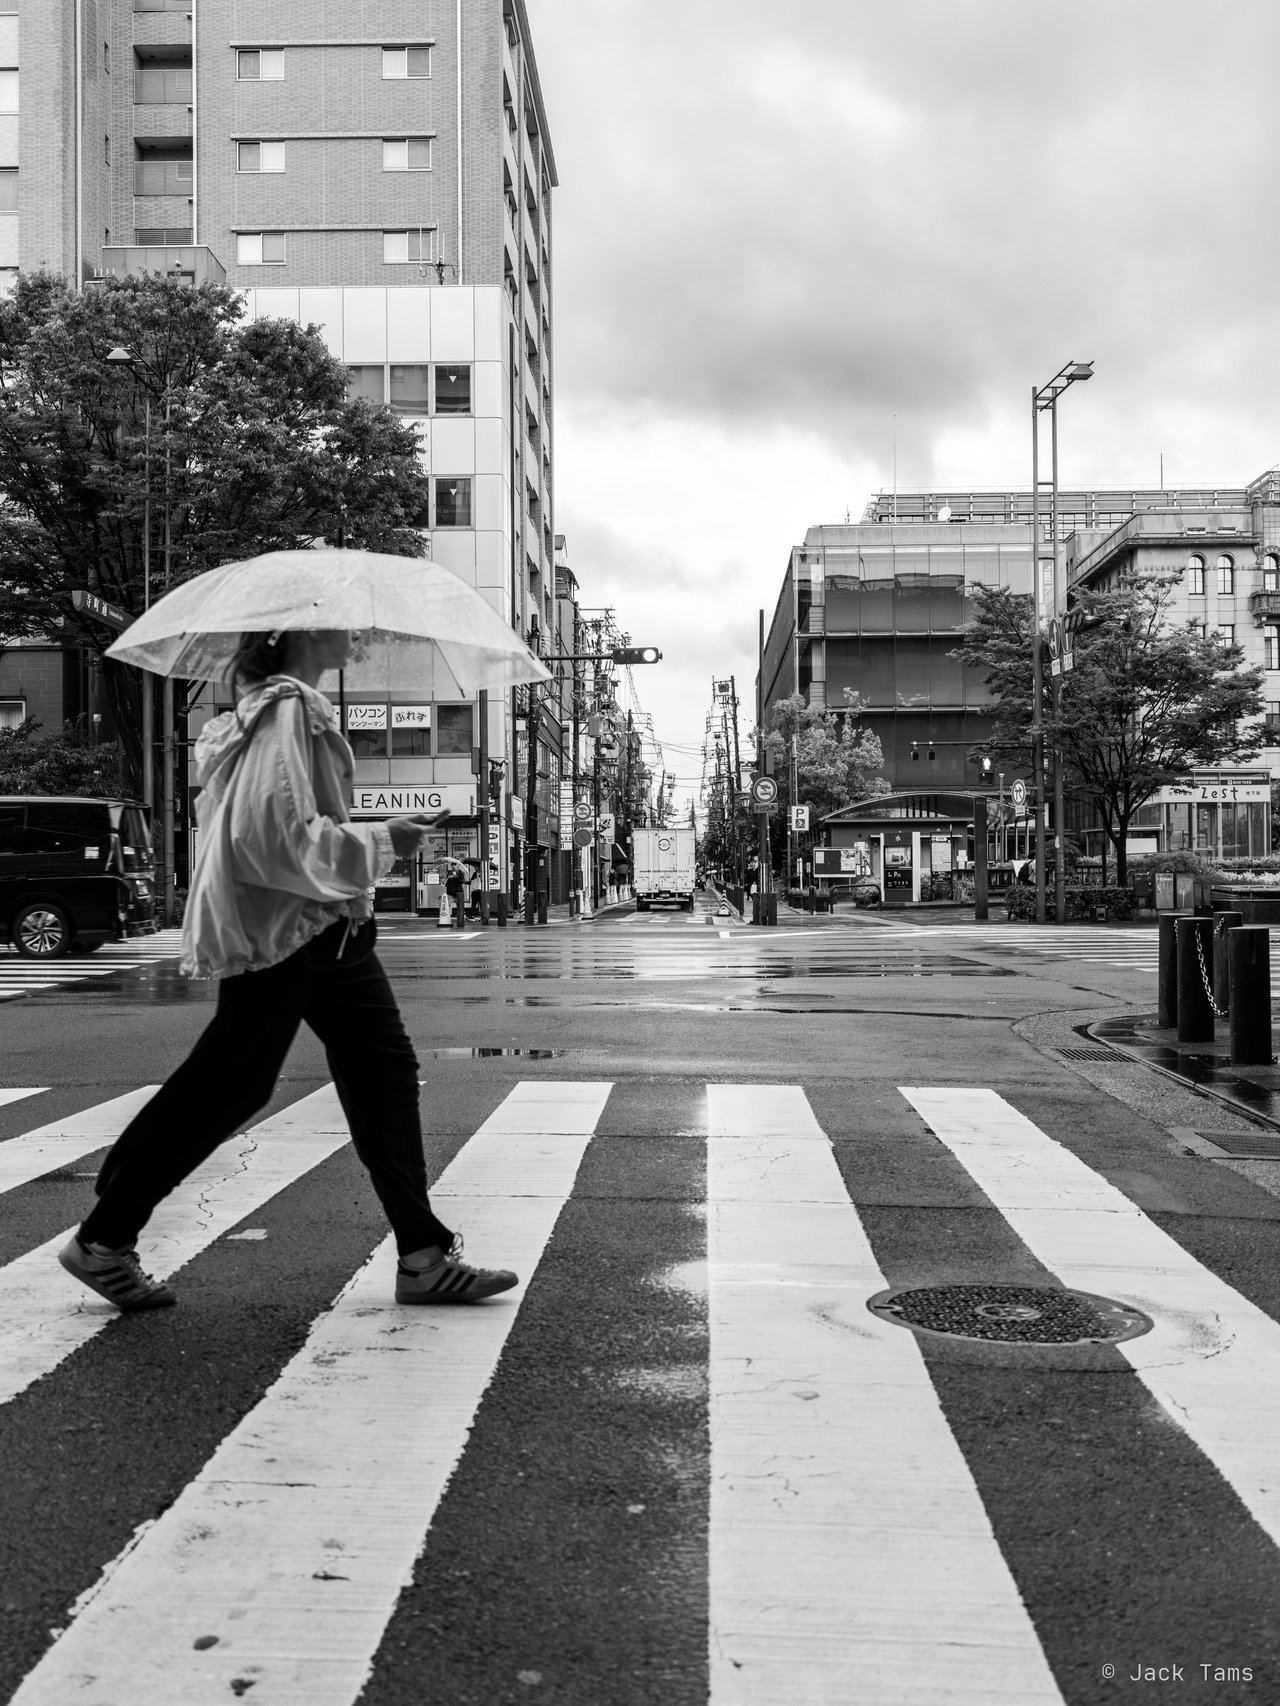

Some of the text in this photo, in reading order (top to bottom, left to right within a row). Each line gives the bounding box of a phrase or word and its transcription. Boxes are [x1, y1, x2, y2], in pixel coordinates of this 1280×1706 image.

[348, 707, 386, 718] パソコン
[351, 793, 442, 809] EANING
[796, 808, 805, 818] P
